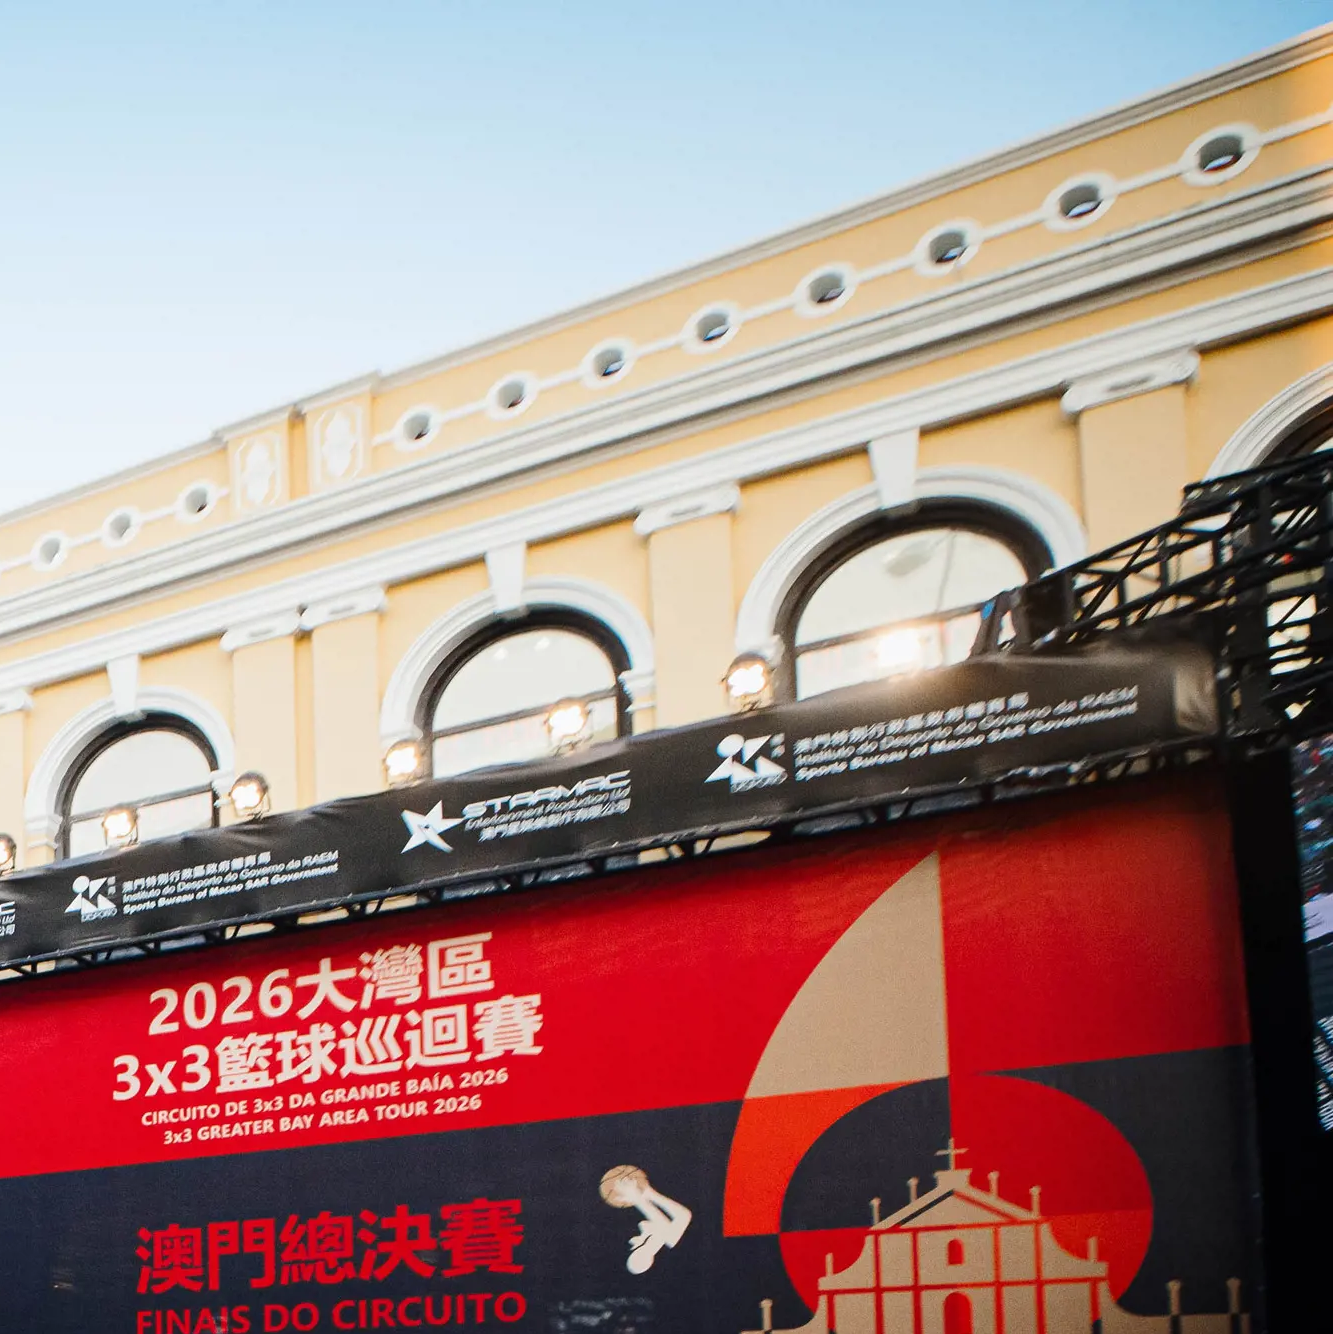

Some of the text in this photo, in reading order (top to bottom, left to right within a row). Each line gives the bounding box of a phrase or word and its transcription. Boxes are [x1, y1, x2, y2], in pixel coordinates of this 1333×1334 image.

[462, 770, 631, 819] STARMAC
[148, 932, 495, 1035] 2026大灣區
[112, 994, 544, 1100] 3x3籃球巡迴賽
[142, 1068, 507, 1124] CIRCUITO DE 3x3 DA GRANDE BAÍA 2026
[164, 1095, 480, 1143] 3x3 GREATER BAY AREA TOUR 2026
[136, 1198, 525, 1293] 澳門總決賽
[137, 1293, 524, 1334] FINAIS DO CIRCUITO
